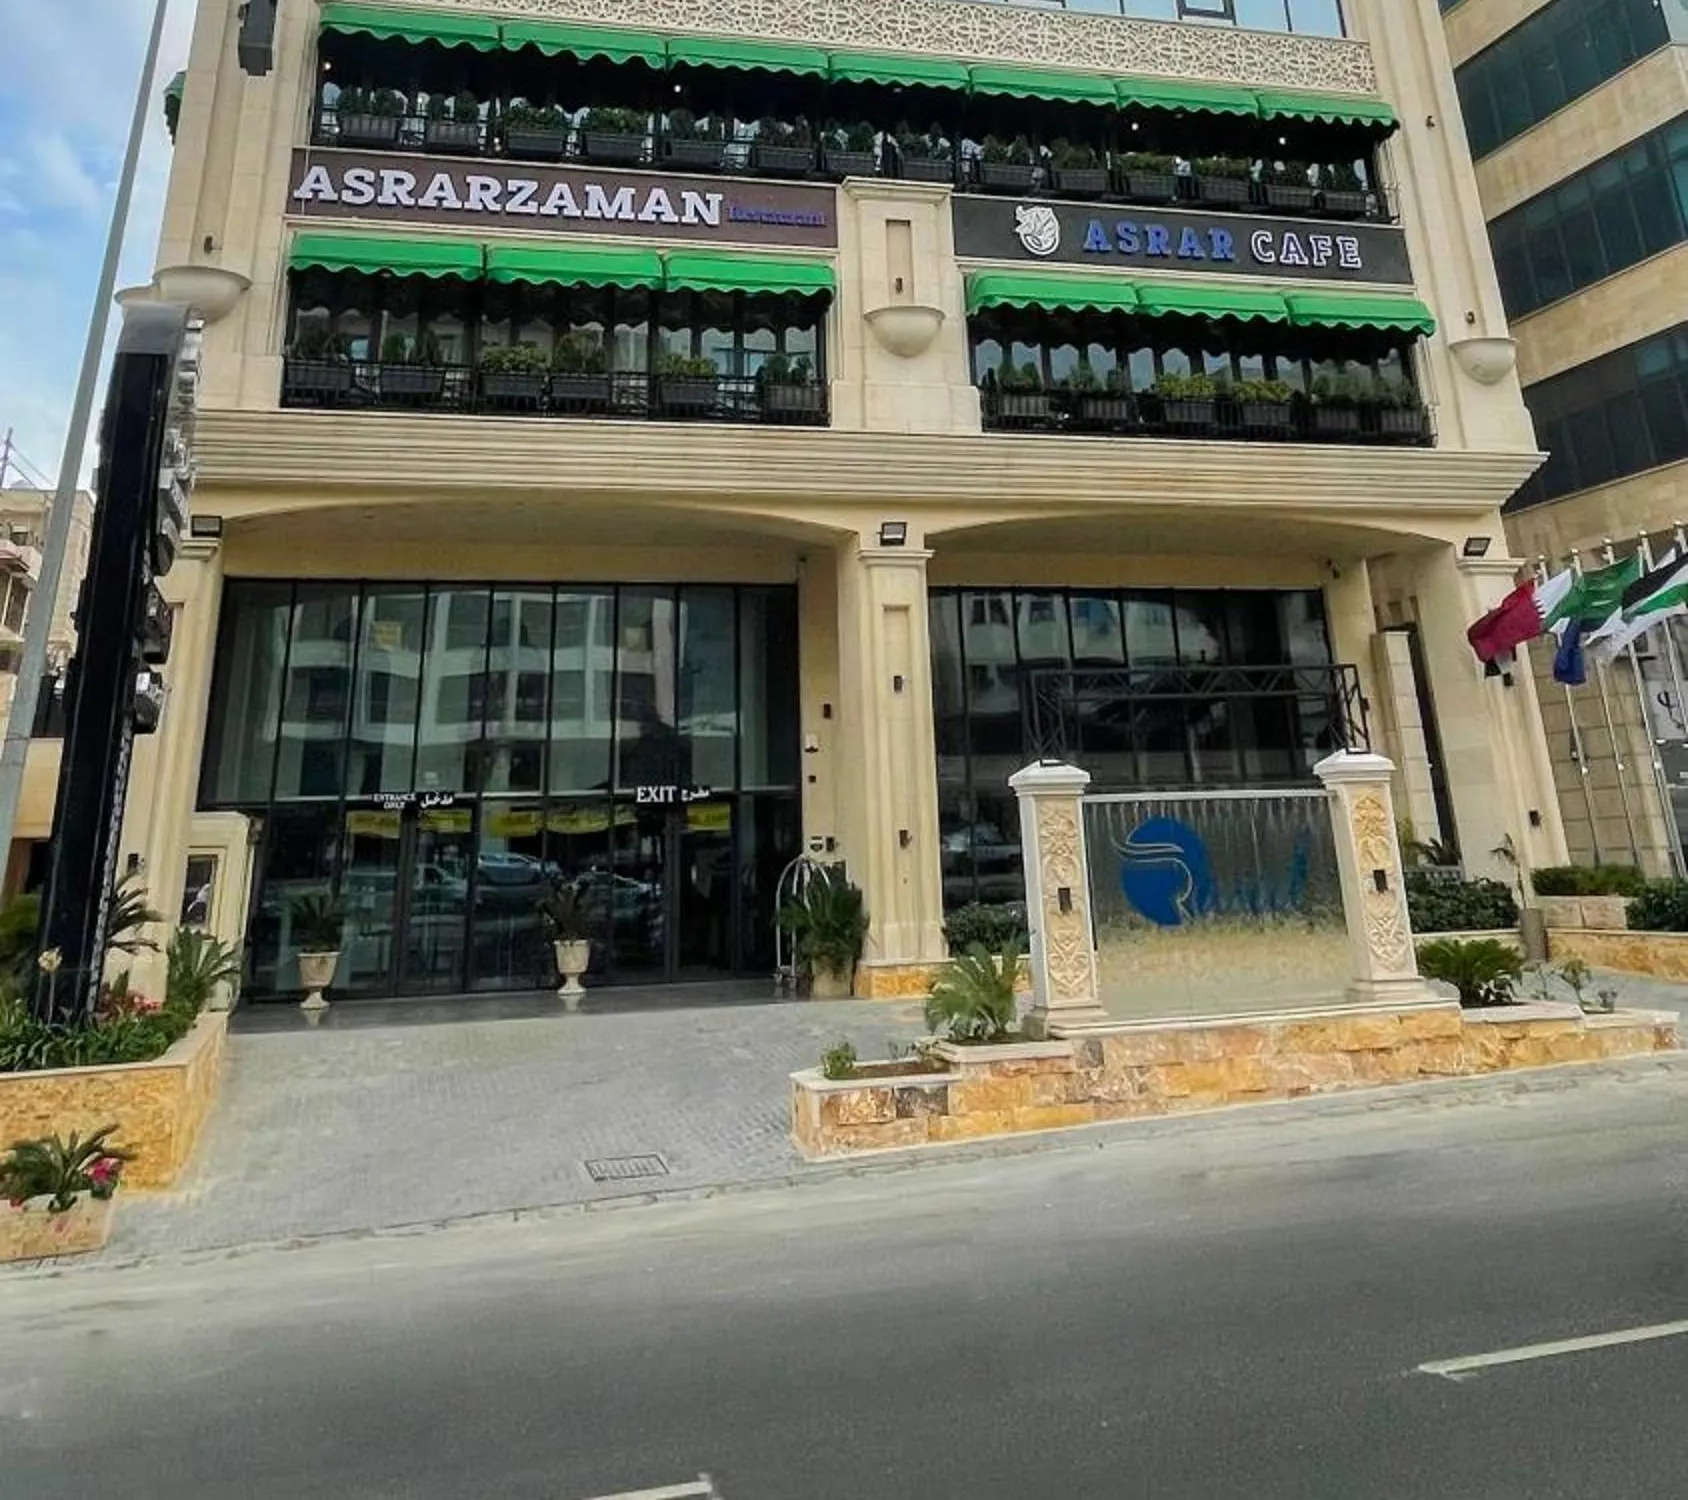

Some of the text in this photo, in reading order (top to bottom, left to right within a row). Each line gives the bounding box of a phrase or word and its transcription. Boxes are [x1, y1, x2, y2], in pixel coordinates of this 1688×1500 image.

[294, 165, 723, 226] ASRARZAMAN
[1083, 219, 1363, 270] ASRAR CAFE
[636, 786, 677, 803] EXIT
